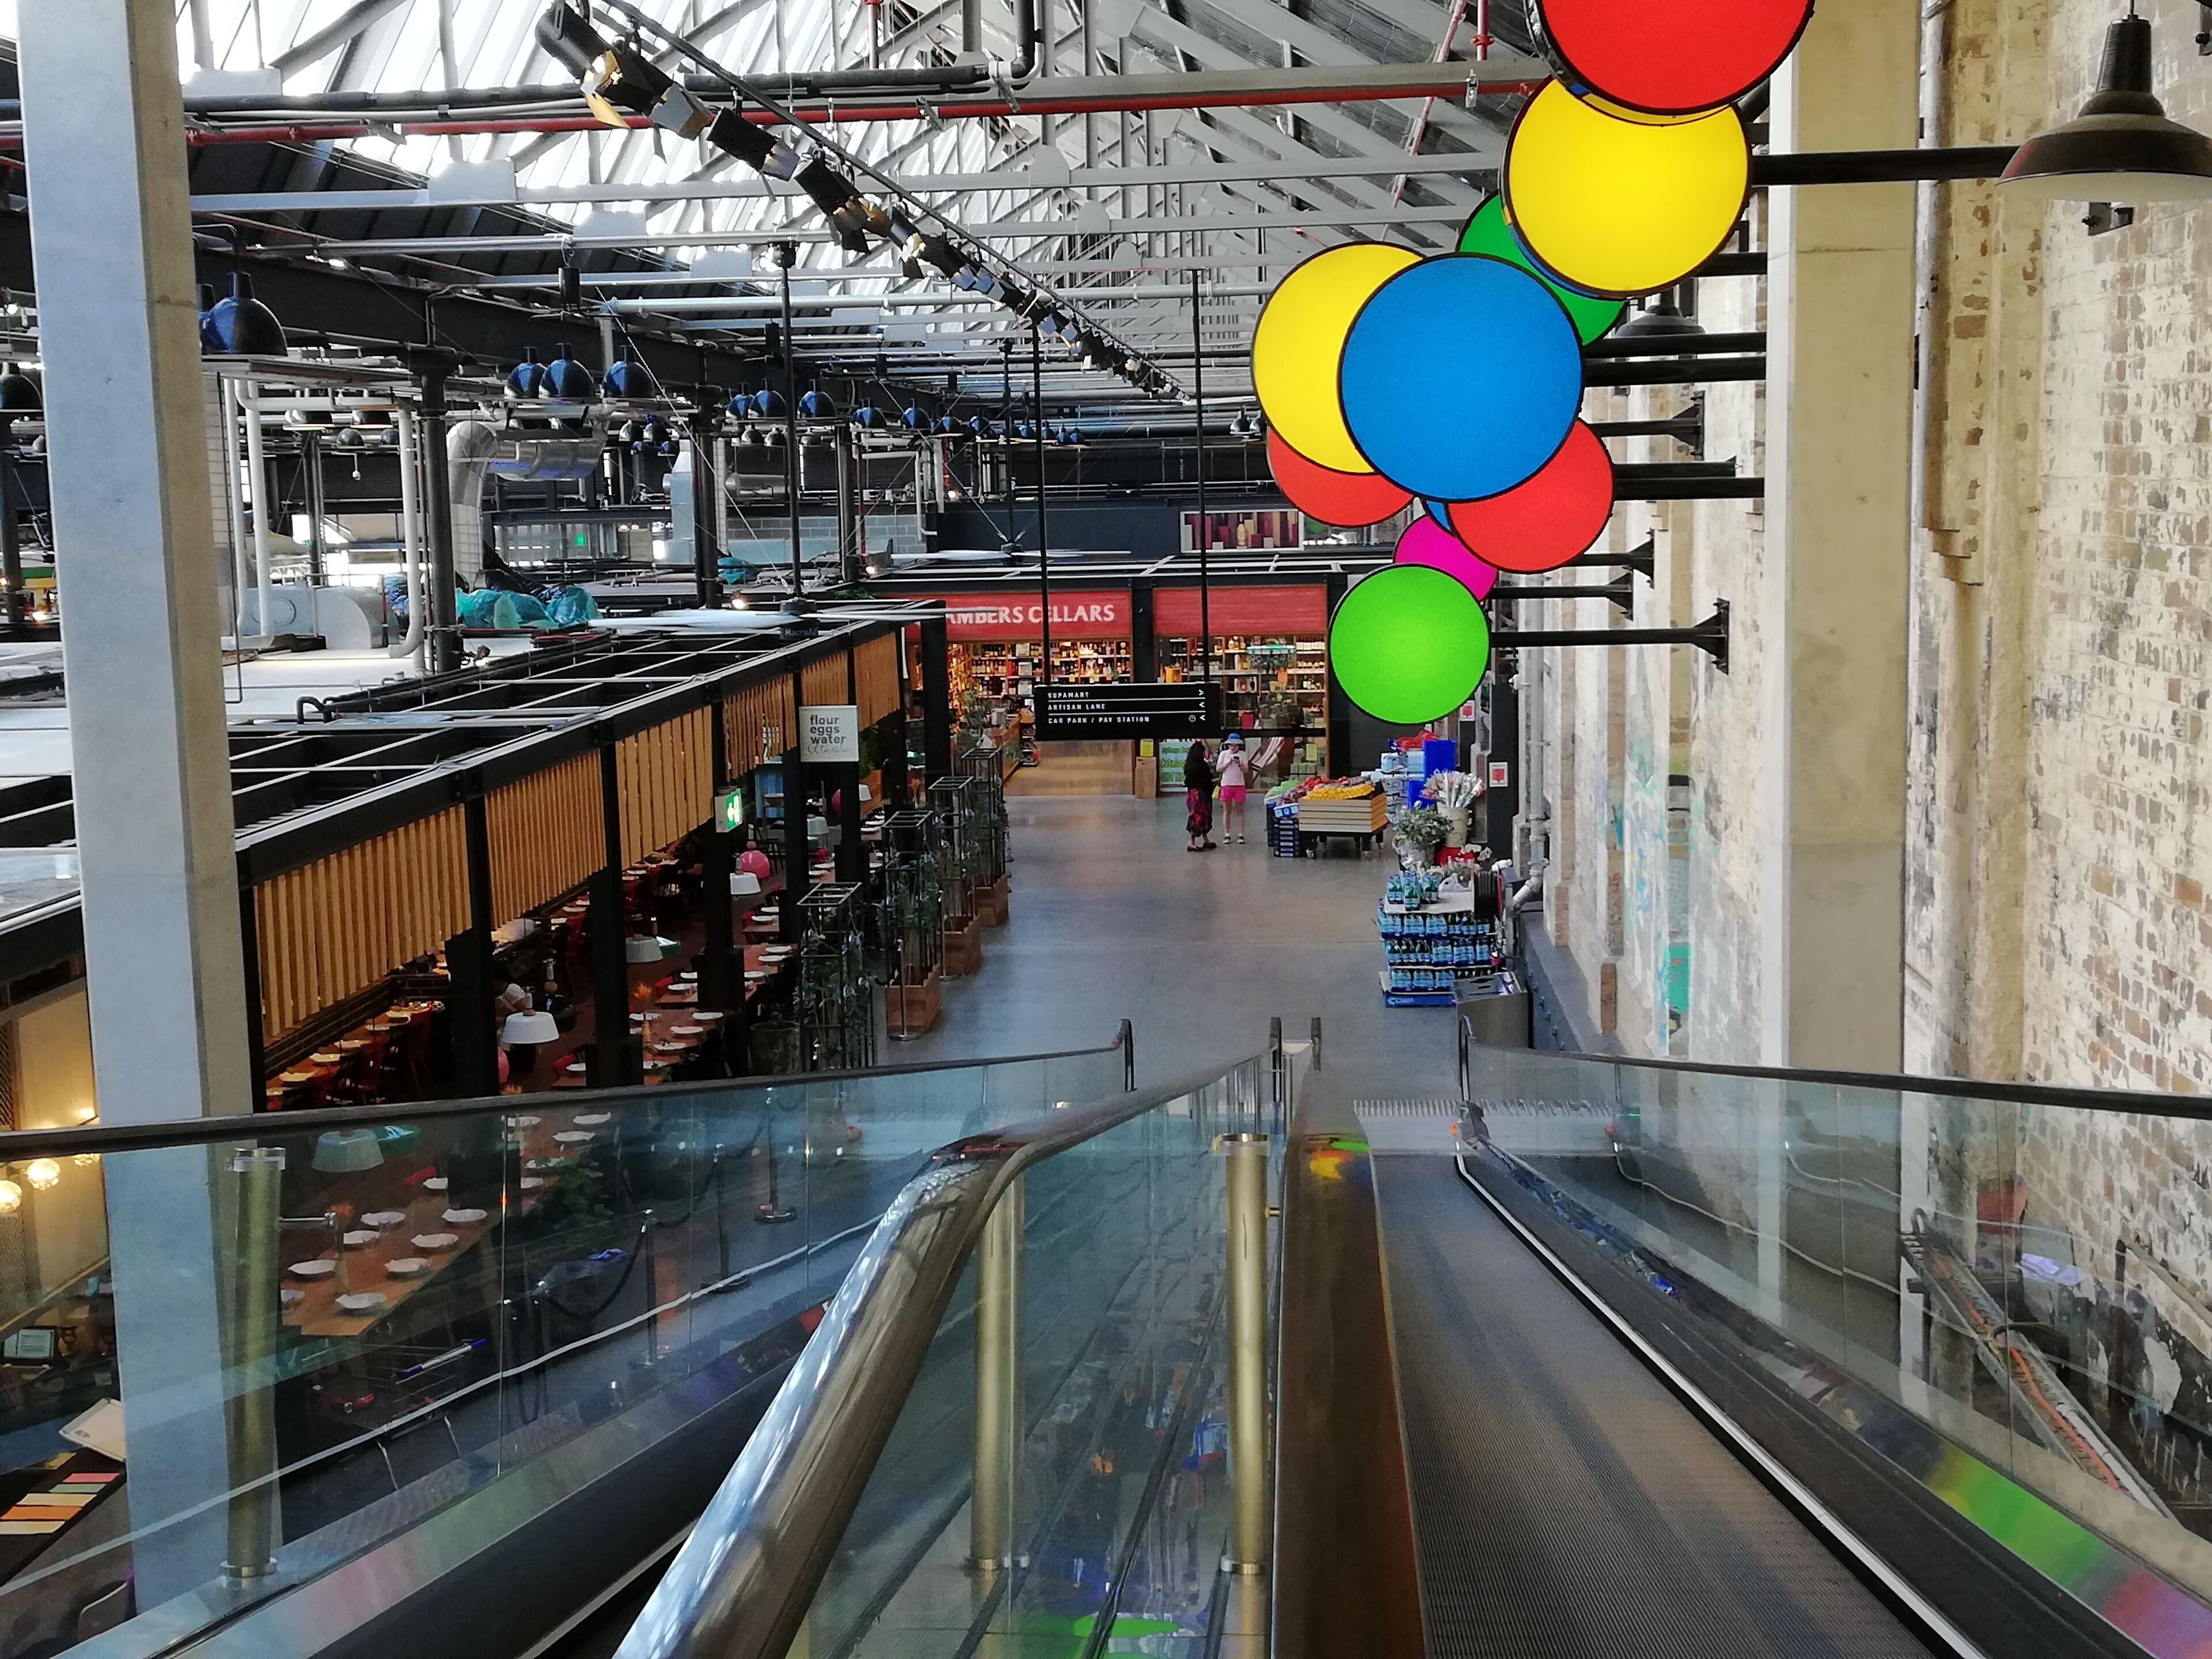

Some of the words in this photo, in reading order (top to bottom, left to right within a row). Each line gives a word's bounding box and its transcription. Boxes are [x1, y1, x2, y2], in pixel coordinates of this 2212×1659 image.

[810, 714, 840, 725] flour
[810, 726, 840, 736] eggs
[810, 735, 846, 744] water
